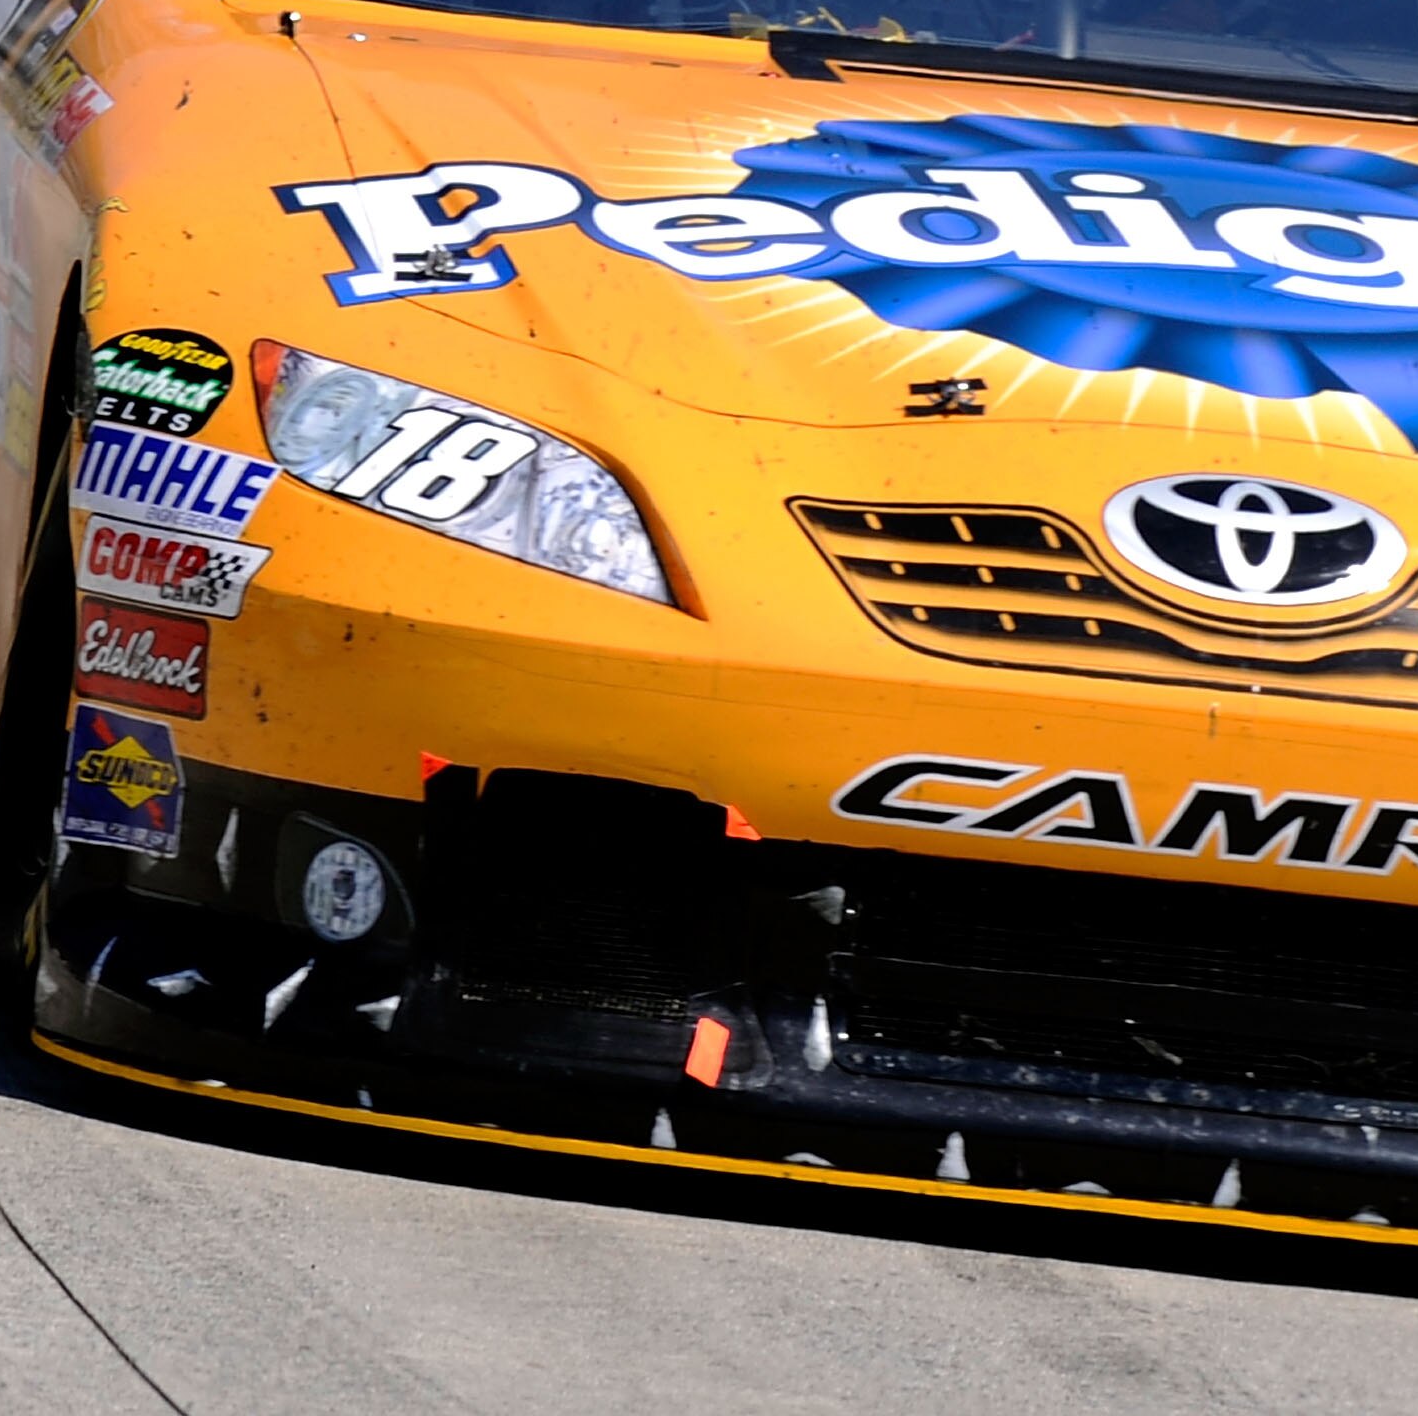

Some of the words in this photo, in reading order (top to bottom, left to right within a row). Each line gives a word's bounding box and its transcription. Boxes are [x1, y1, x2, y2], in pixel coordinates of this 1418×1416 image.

[119, 333, 228, 370] GOODYEAR
[93, 396, 193, 432] ELTS
[76, 425, 277, 522] MAHLE
[333, 406, 539, 521] 18
[88, 527, 210, 590] COMP
[79, 620, 204, 694] Edelbrock
[81, 751, 175, 790] SUNOCO
